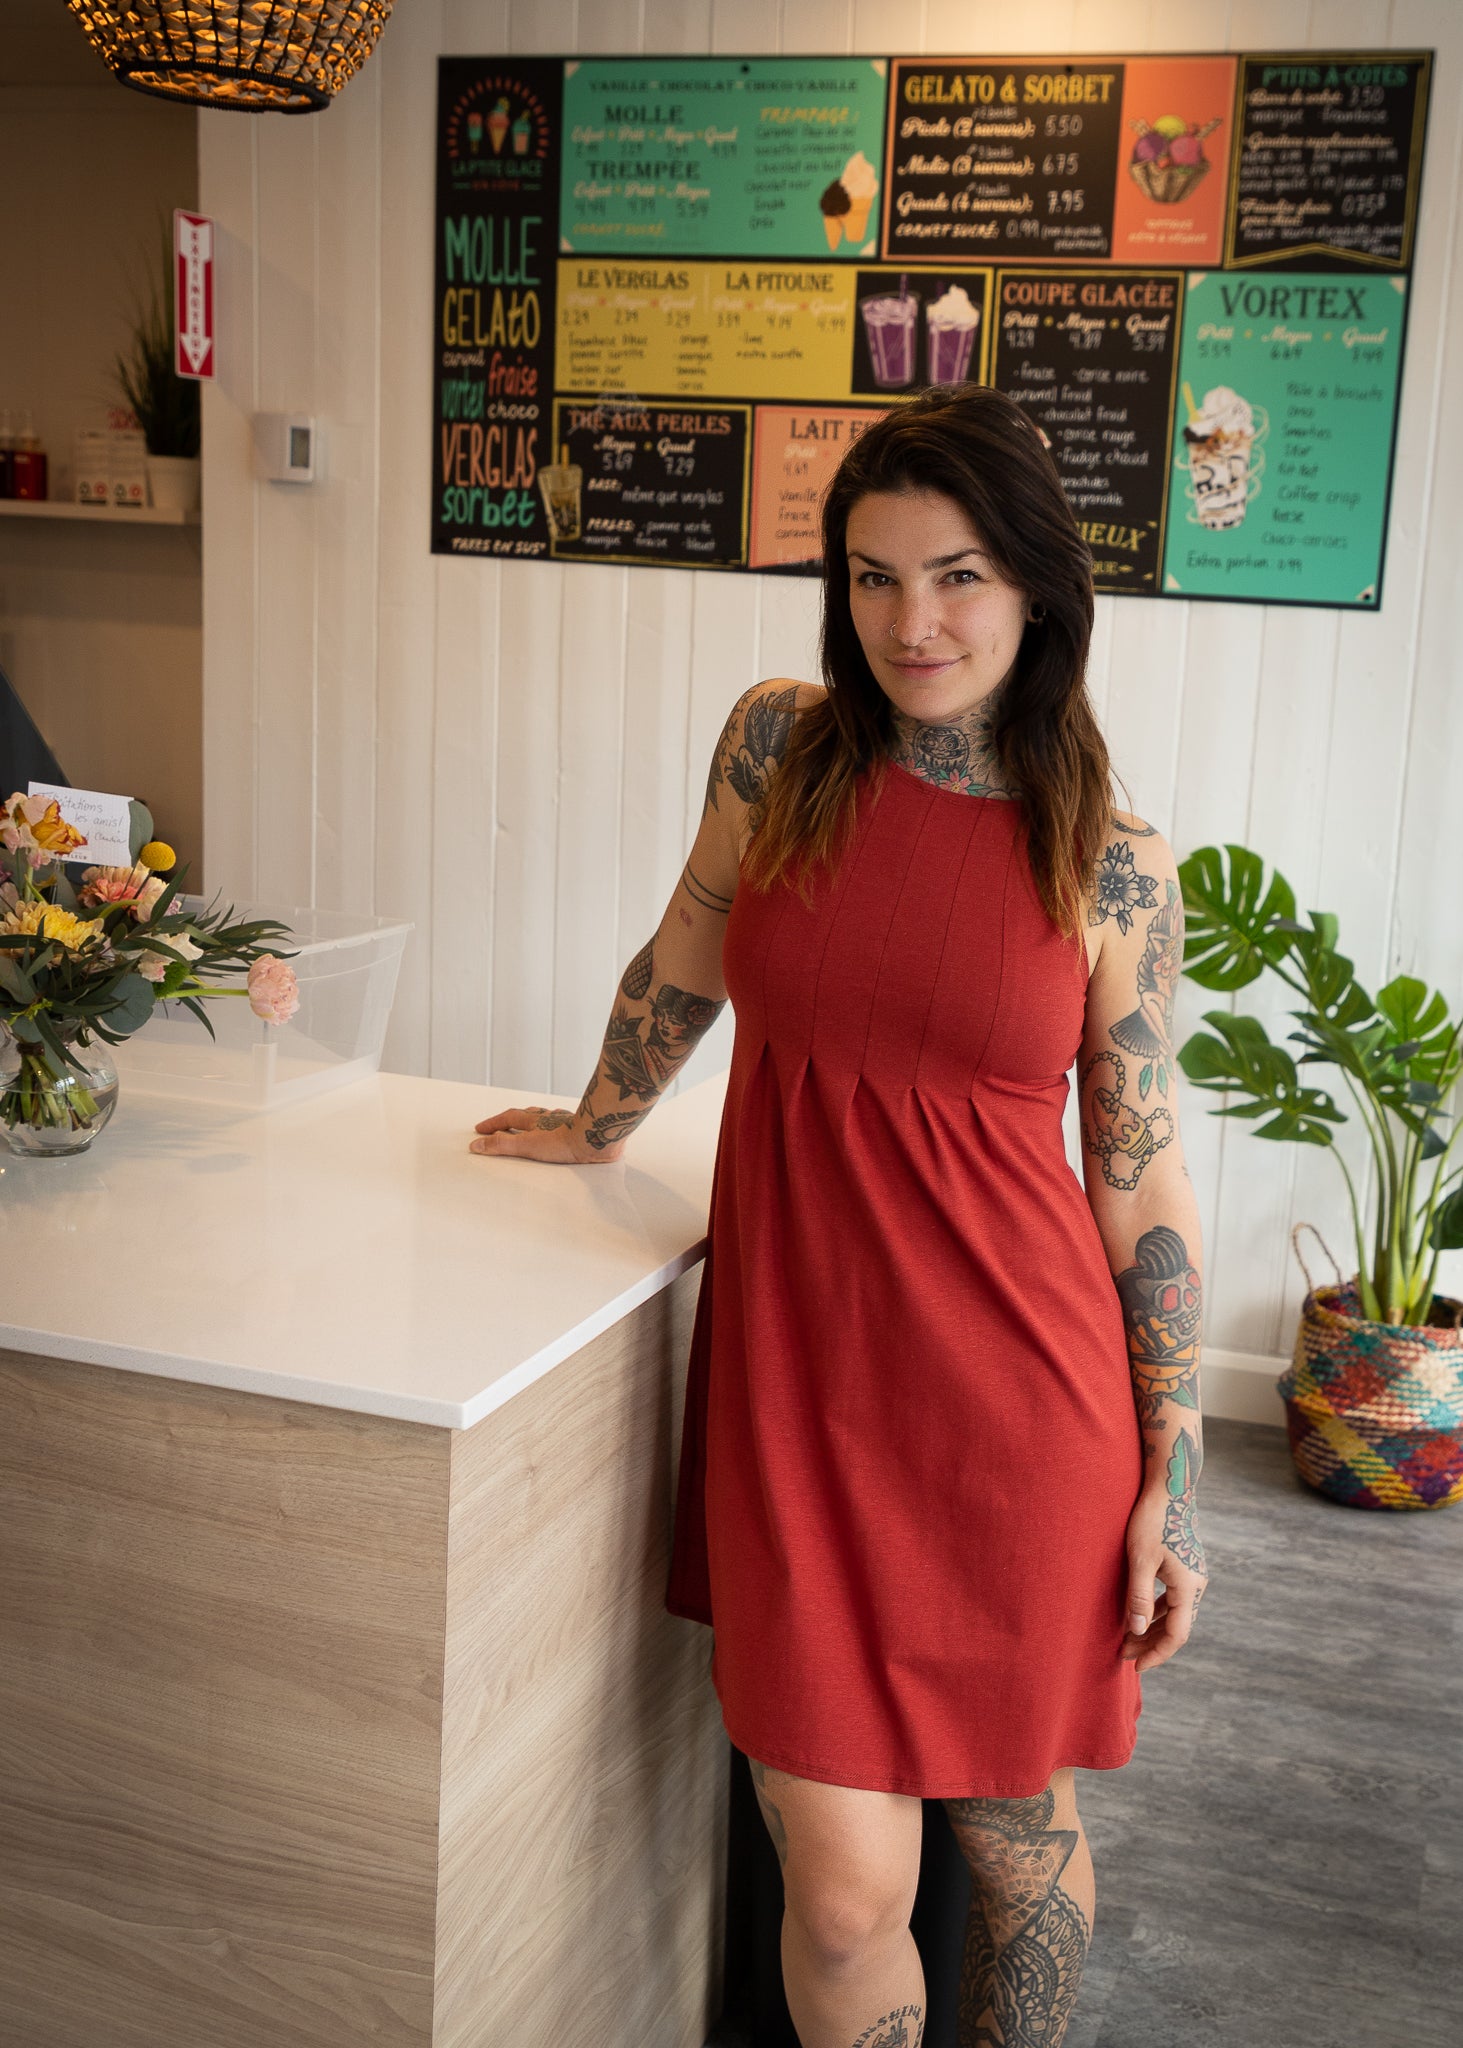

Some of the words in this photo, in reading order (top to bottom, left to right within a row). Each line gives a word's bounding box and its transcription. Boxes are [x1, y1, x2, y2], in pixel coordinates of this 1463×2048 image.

[590, 79, 648, 92] VANILLE
[659, 80, 734, 92] CHOCOLAT
[904, 75, 996, 105] GELATO
[1000, 74, 1017, 104] &
[1023, 74, 1115, 104] SORBET
[604, 105, 684, 125] MOLLE
[1047, 189, 1085, 215] 7.95
[443, 213, 543, 286] MOLLE
[576, 268, 600, 290] LE
[603, 267, 691, 291] VERGLAS
[725, 271, 750, 291] LA
[756, 271, 835, 293] PITOUNE
[1003, 281, 1077, 307] COUPE
[1081, 280, 1175, 308] GLACÉE
[1220, 280, 1367, 321] VORTEX
[1002, 310, 1040, 329] Petit
[1056, 311, 1106, 333] Moyen
[1125, 313, 1170, 336] Grand
[1196, 323, 1235, 341] Petit
[1261, 325, 1314, 347] Moyen
[1341, 327, 1390, 349] Grand
[488, 350, 538, 398] fraise
[487, 397, 540, 421] choco
[609, 411, 651, 432] AUX
[656, 413, 733, 436] PERLES
[789, 417, 844, 441] LAIT
[441, 420, 539, 489] VERGLAS
[593, 435, 637, 455] Moyen
[656, 436, 696, 458] Grand
[440, 486, 537, 528] sorbet
[1075, 521, 1148, 553] IEUX
[1186, 550, 1222, 568] Extra
